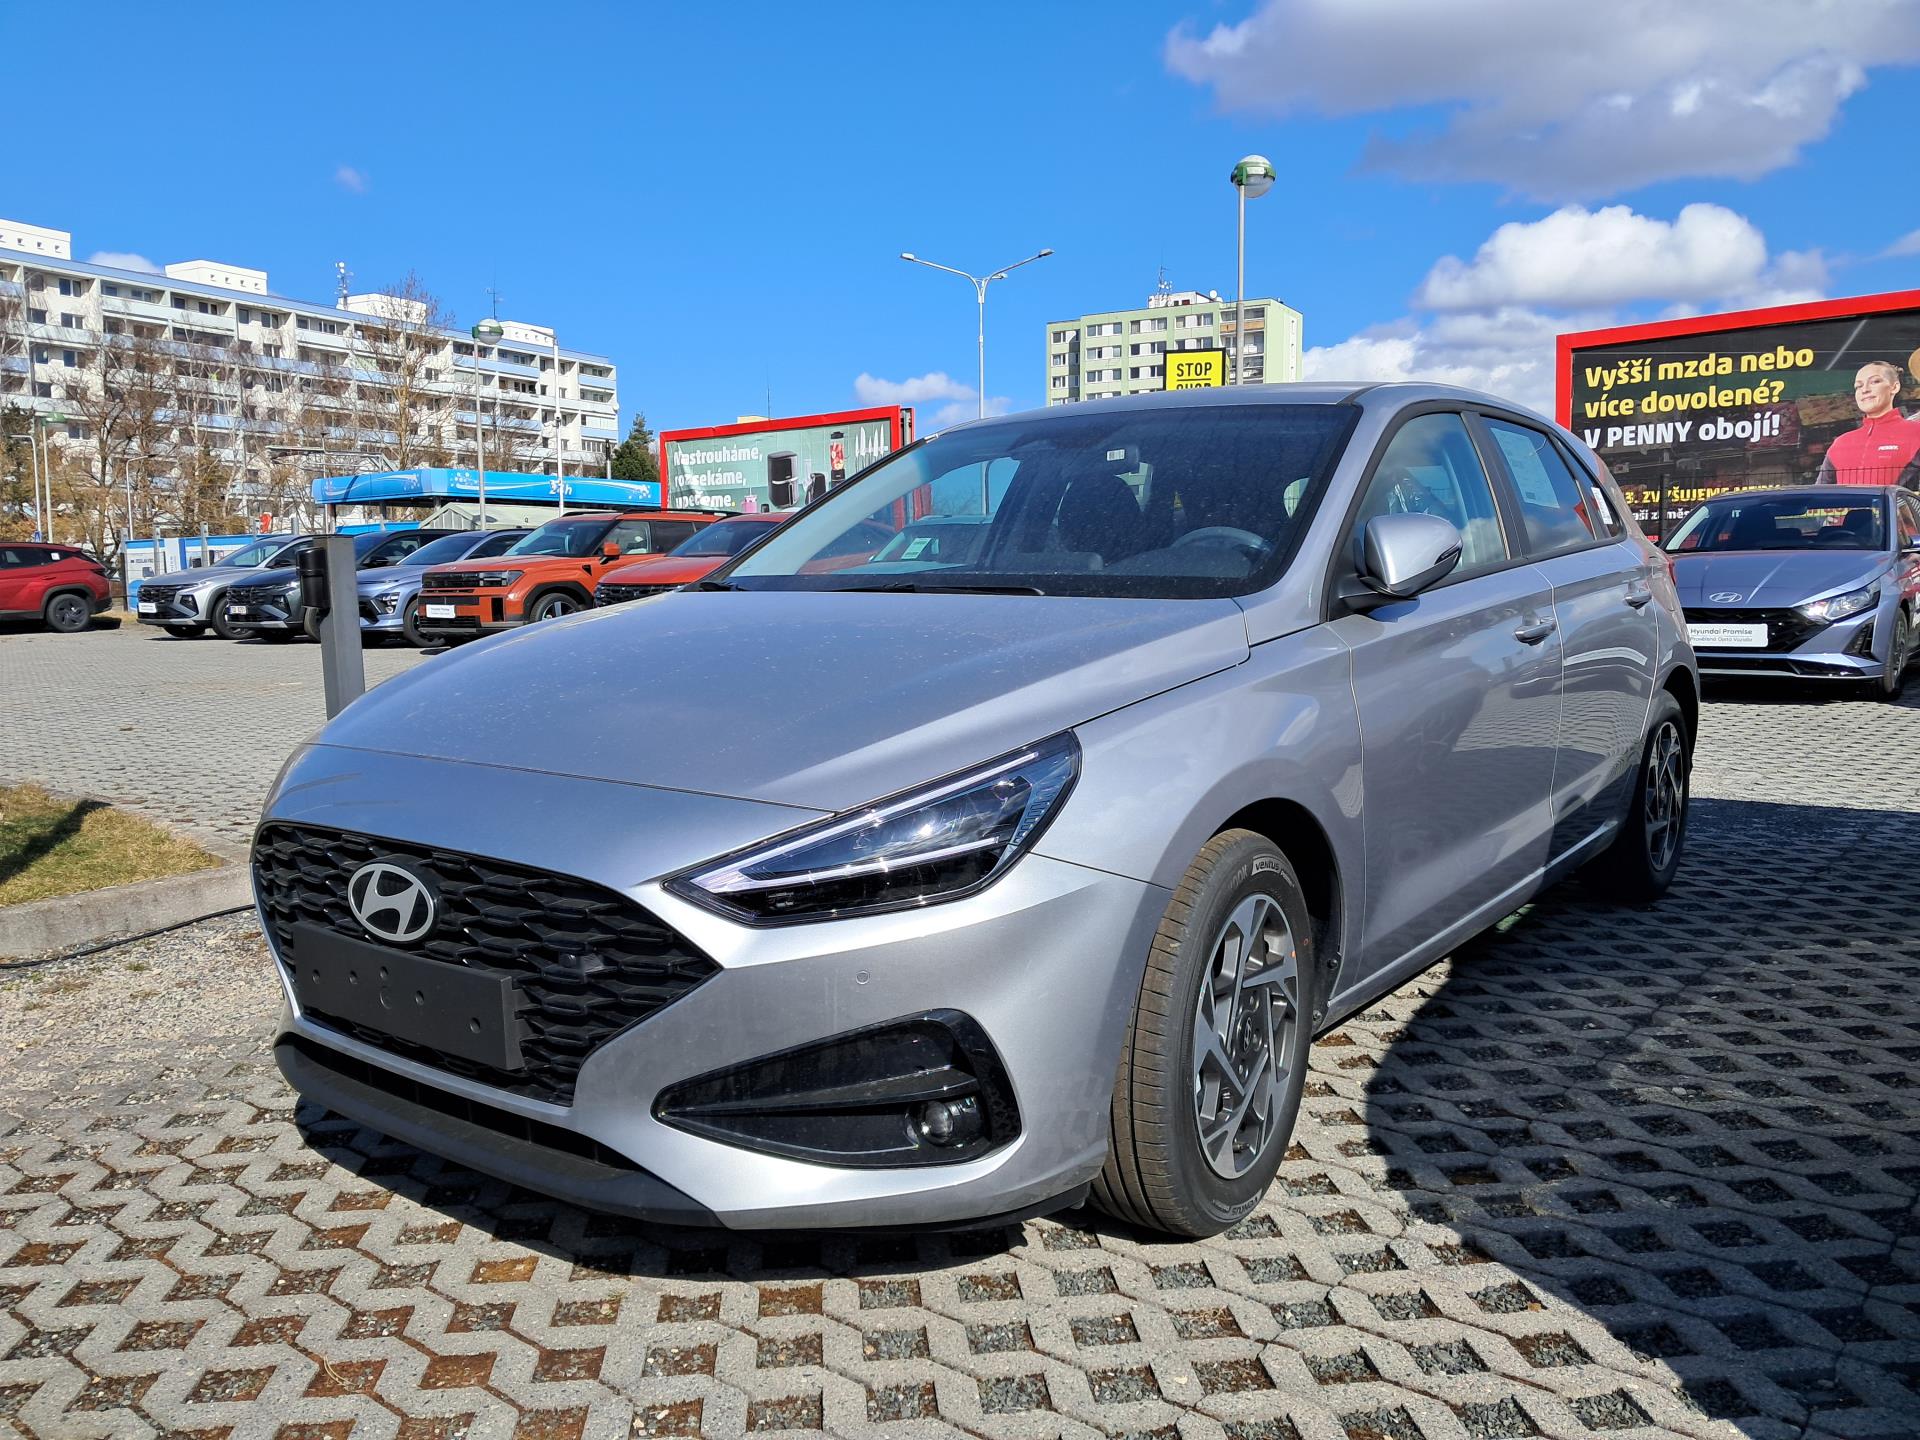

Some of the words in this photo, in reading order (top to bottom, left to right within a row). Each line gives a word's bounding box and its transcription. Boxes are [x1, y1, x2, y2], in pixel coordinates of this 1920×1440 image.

[1176, 362, 1212, 377] STOP
[1585, 358, 1651, 391] Vyšší
[1658, 352, 1733, 381] mzda
[1741, 345, 1814, 373] nebo
[1585, 397, 1634, 419] více
[1641, 380, 1785, 414] dovolené?
[1584, 428, 1601, 449] V
[1607, 421, 1694, 447] PENNY
[1699, 413, 1780, 443] obojí!
